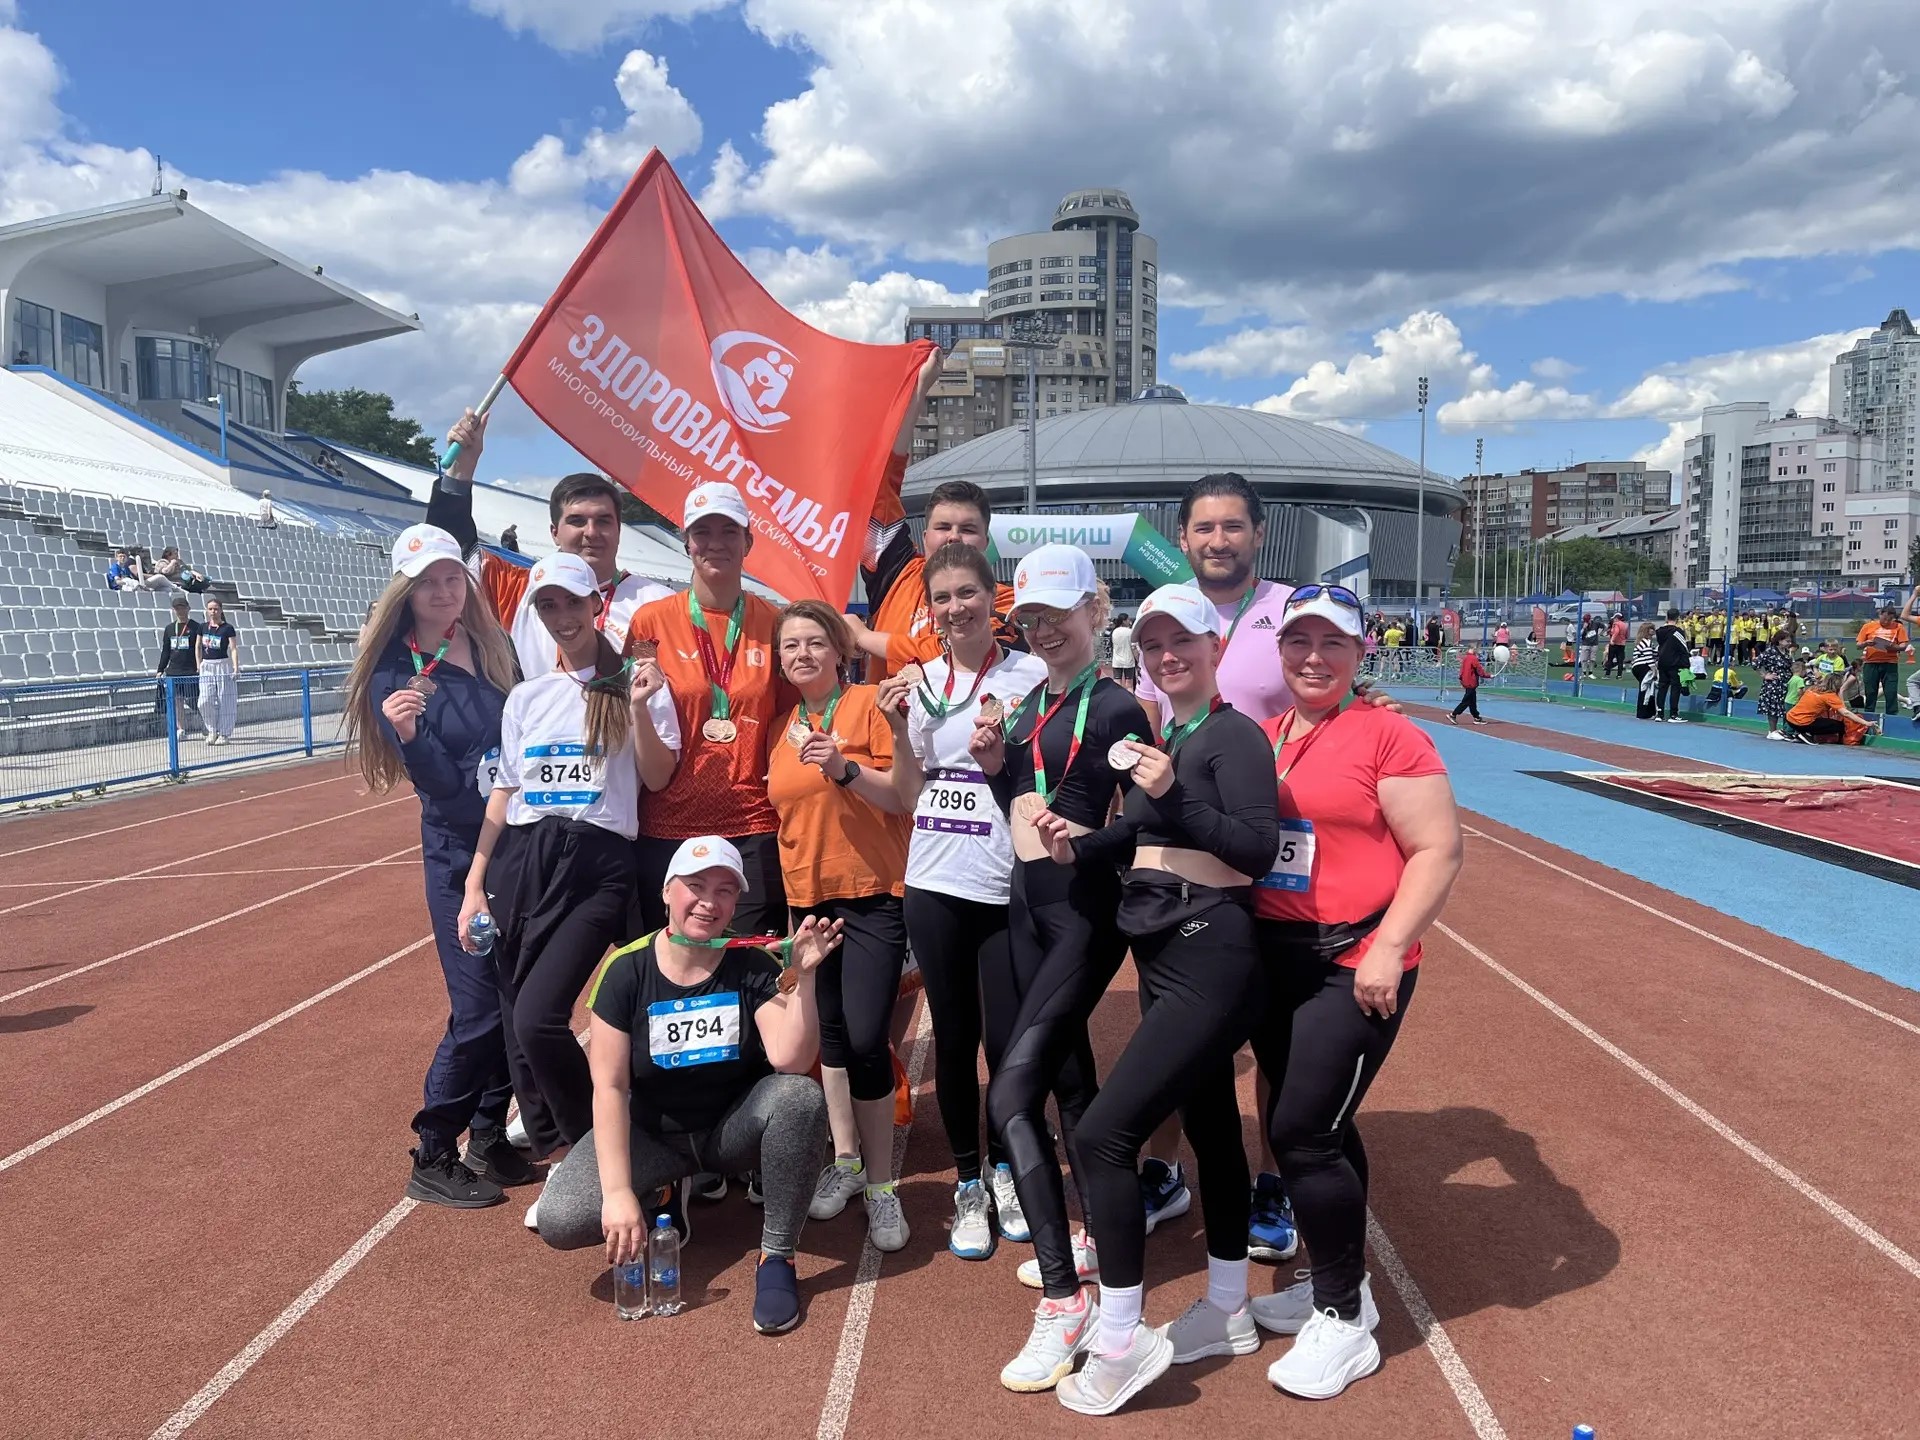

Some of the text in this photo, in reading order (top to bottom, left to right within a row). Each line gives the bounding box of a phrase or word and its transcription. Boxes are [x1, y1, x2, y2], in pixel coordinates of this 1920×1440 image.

[548, 356, 694, 482] МНОГОПРОФИЛЬНЫЙ
[1007, 526, 1111, 546] ФИНИШ
[1138, 545, 1174, 577] марафон
[1144, 539, 1180, 571] зелёный
[745, 647, 765, 668] 10
[540, 764, 592, 783] 8749
[930, 789, 976, 811] 7896
[667, 1015, 724, 1043] 8794
